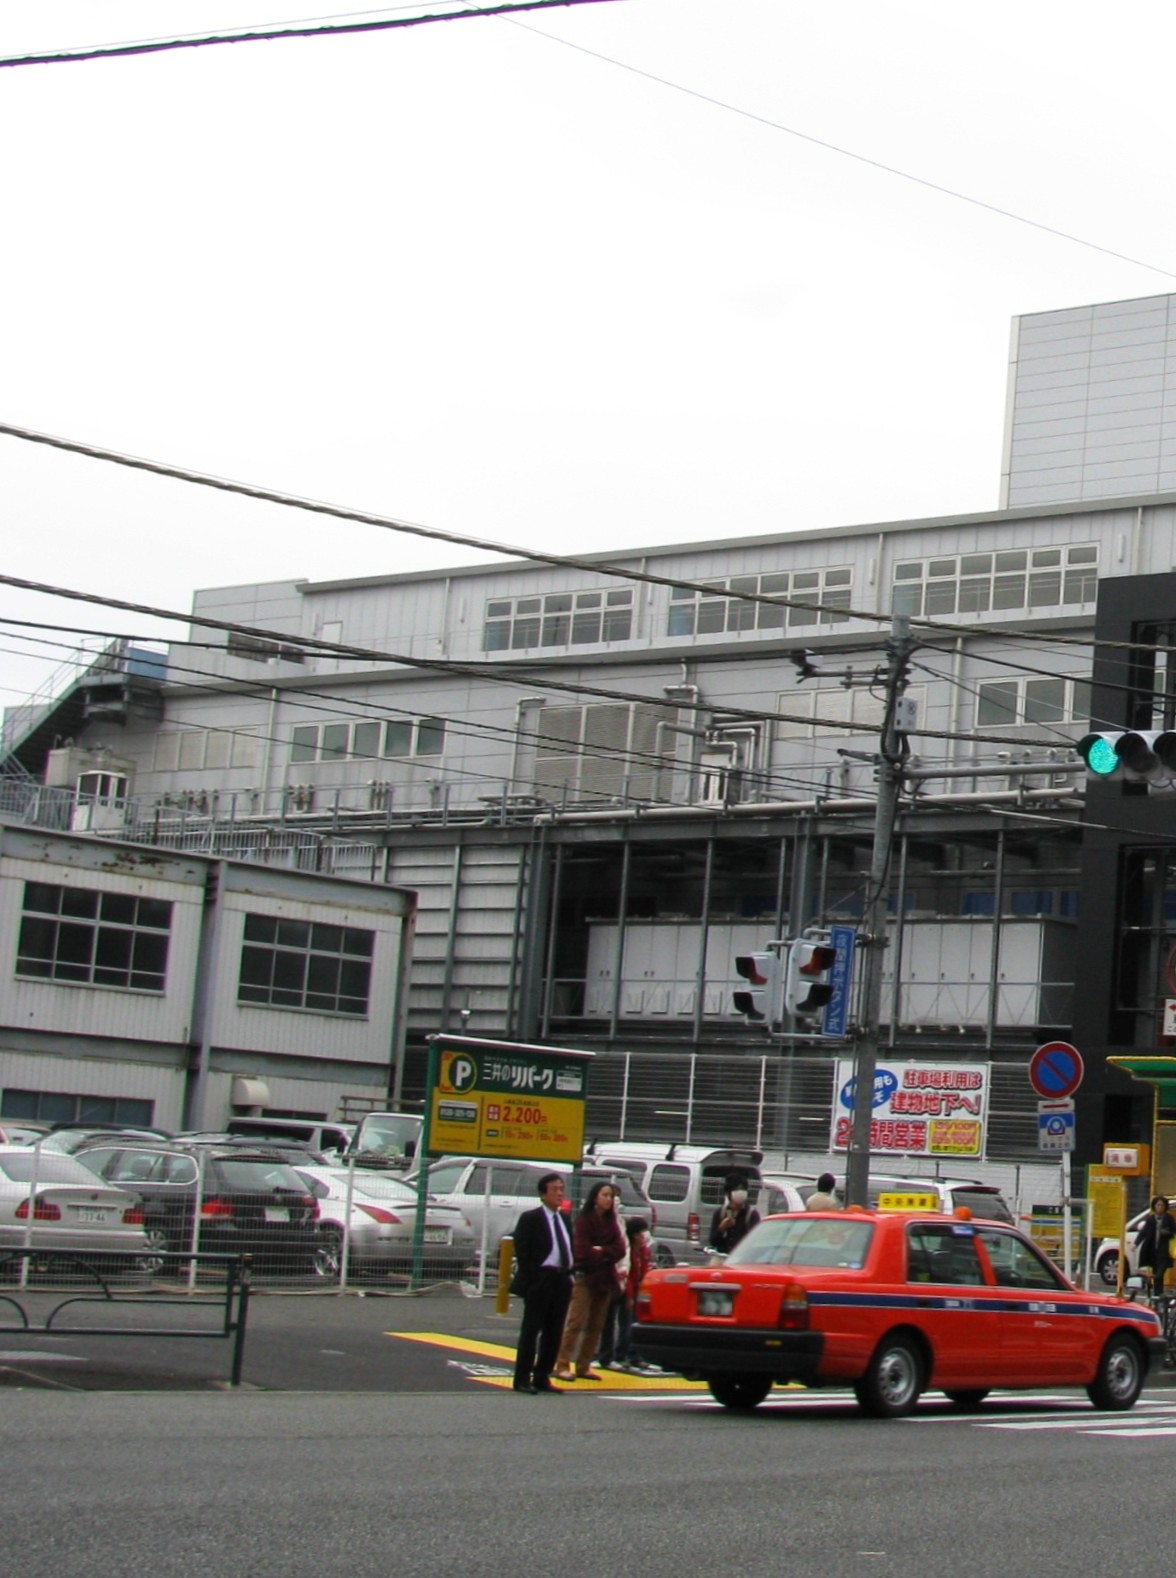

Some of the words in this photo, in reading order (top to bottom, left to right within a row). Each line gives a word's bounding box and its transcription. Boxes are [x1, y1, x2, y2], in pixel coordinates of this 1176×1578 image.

[455, 1060, 472, 1087] P
[482, 1062, 554, 1090] 三井のリパーク
